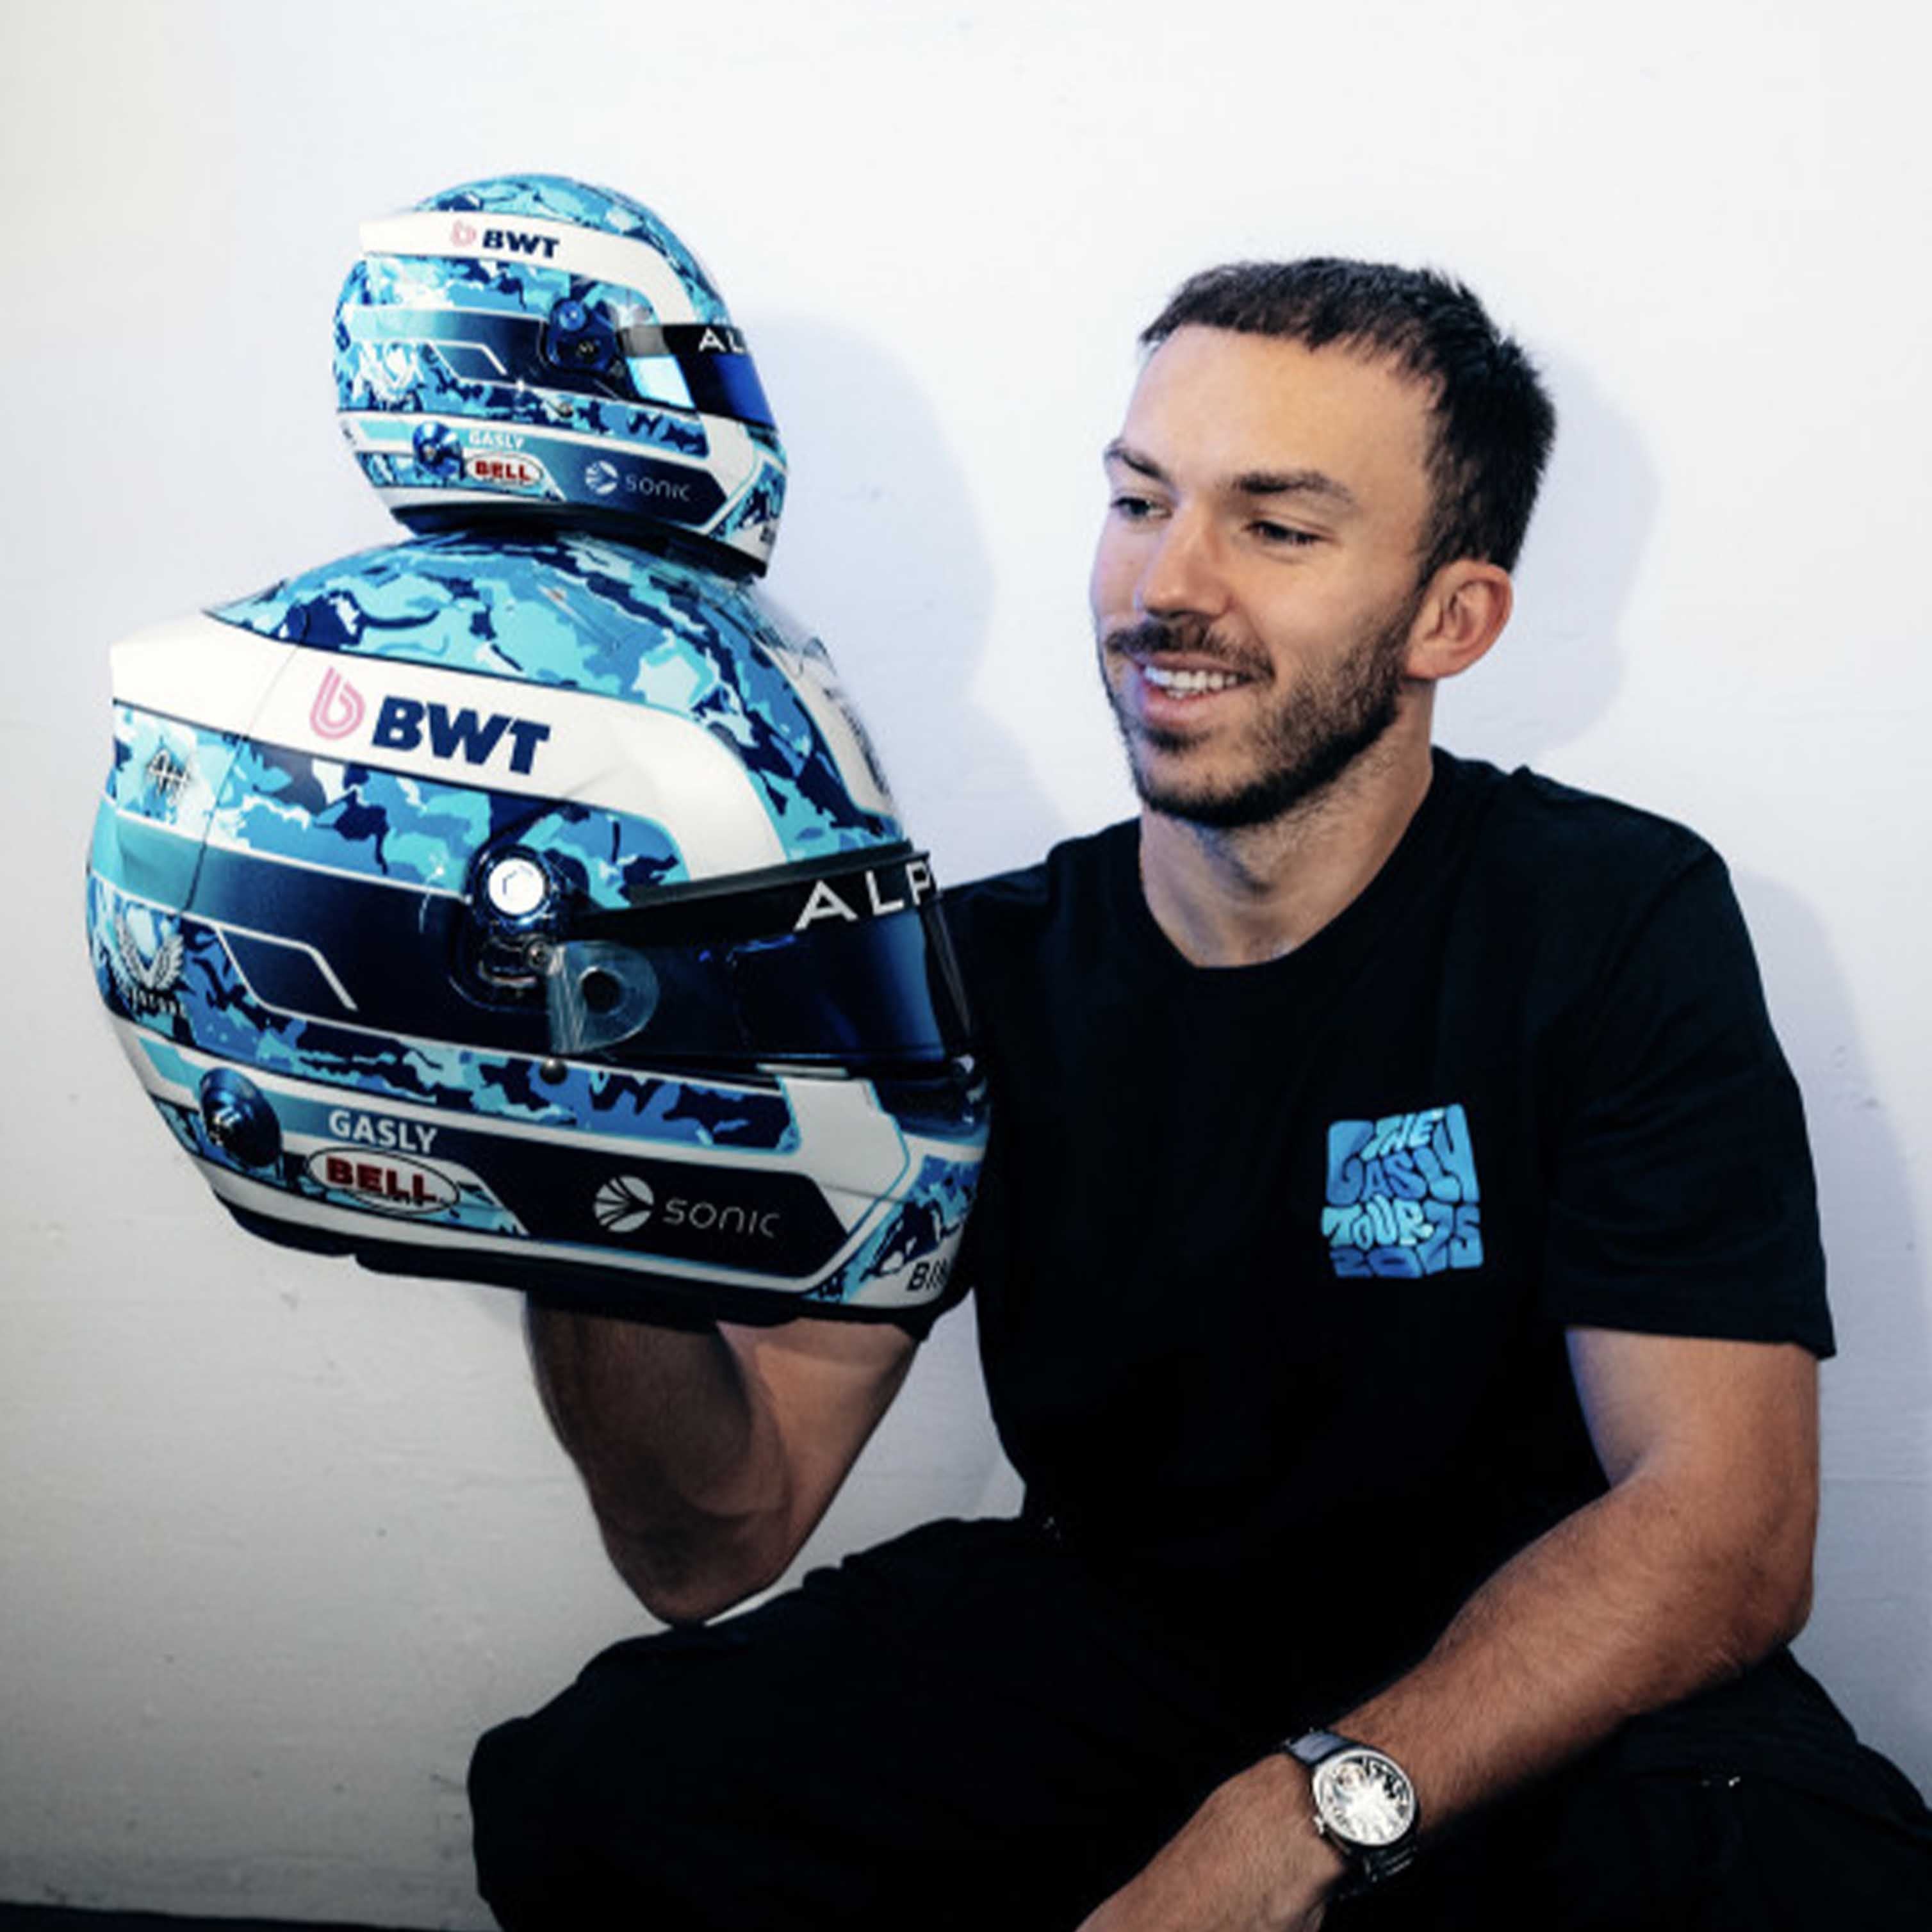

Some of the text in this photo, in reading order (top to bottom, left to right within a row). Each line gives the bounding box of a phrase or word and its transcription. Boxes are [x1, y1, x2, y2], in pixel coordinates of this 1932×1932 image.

[483, 228, 560, 259] BWT
[468, 430, 525, 449] GASLY
[475, 461, 531, 481] BELL
[372, 696, 550, 776] BWT
[793, 861, 931, 932] ALP
[329, 1109, 438, 1154] GASLY
[1325, 1102, 1480, 1206] GASLY
[1359, 1107, 1446, 1161] THE
[326, 1156, 438, 1202] BELL
[1321, 1194, 1434, 1250] TOUR
